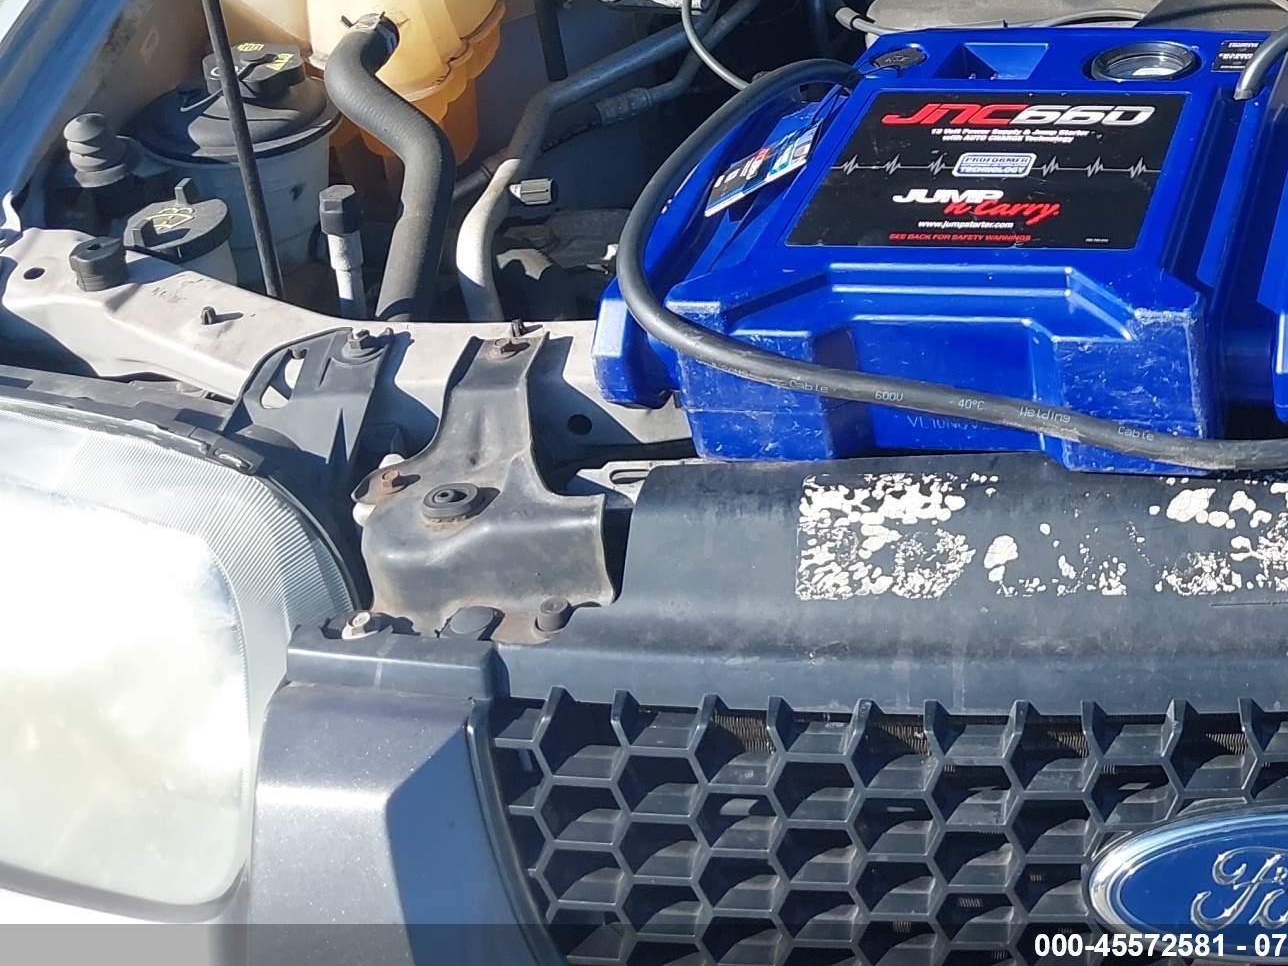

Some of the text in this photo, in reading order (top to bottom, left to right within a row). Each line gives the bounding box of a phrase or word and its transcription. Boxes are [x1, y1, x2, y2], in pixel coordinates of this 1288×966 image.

[881, 103, 1156, 126] JNC660
[892, 188, 1004, 204] JUMP
[917, 220, 1015, 229] www.jumpstarter.com
[888, 233, 1031, 242] SEE BACK FOR SAFETY WARNINGS
